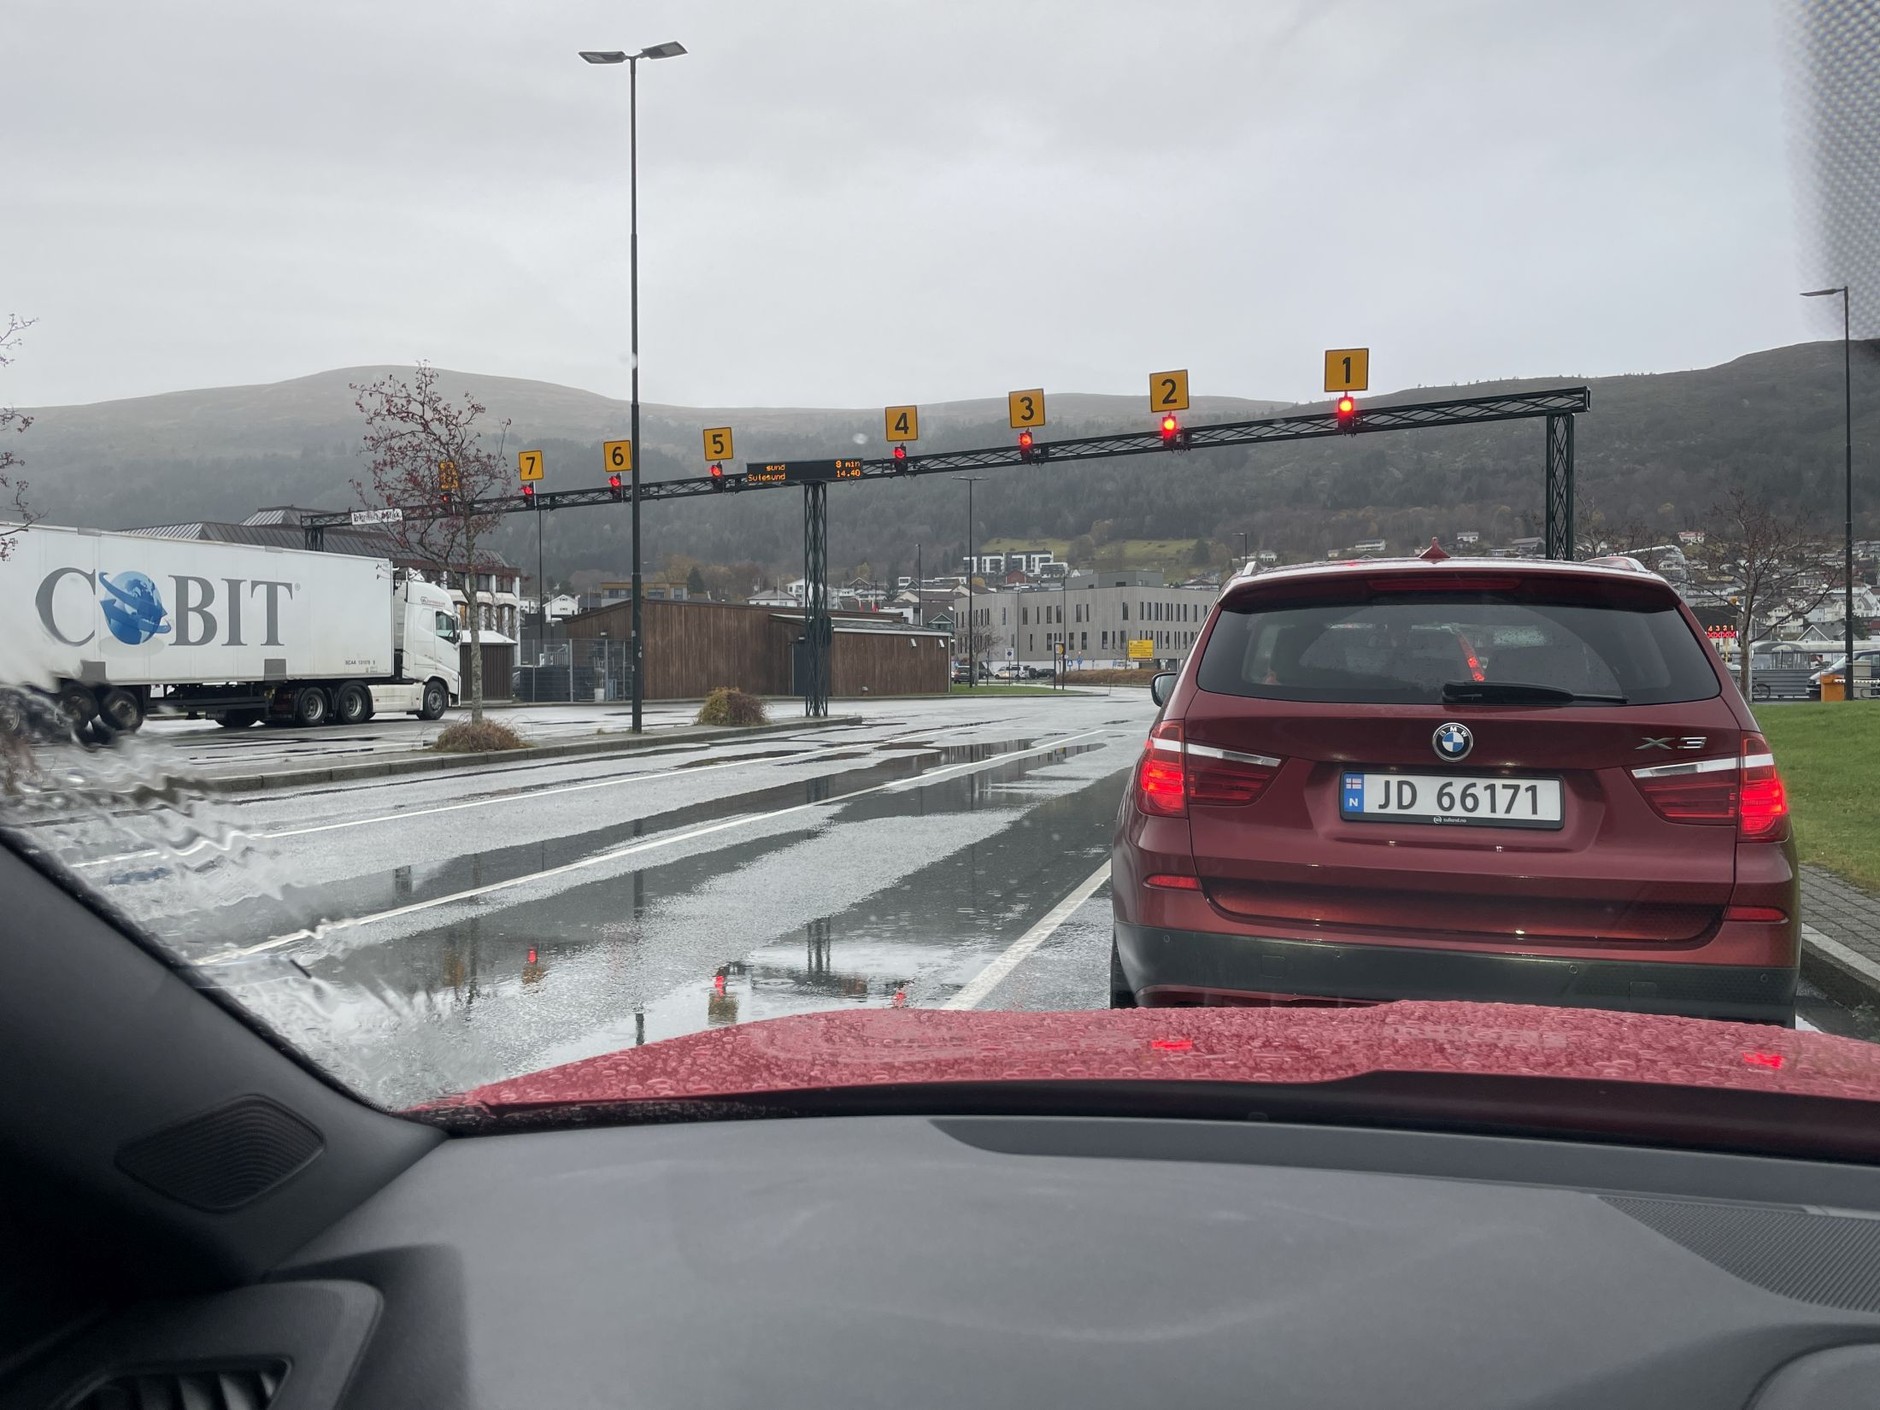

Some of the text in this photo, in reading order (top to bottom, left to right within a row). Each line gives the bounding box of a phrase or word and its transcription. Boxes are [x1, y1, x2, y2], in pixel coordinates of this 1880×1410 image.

[1342, 356, 1351, 384] 1
[1161, 378, 1177, 404] 2
[1020, 396, 1035, 421] 3
[894, 412, 910, 435] 4
[712, 434, 724, 455] 5
[525, 456, 536, 475] 7
[611, 446, 624, 466] 6
[835, 460, 842, 468] 8
[845, 460, 861, 468] min
[836, 469, 861, 478] 14.40
[1635, 736, 1708, 750] X3
[1349, 798, 1358, 807] N
[1378, 780, 1539, 815] JD 66171
